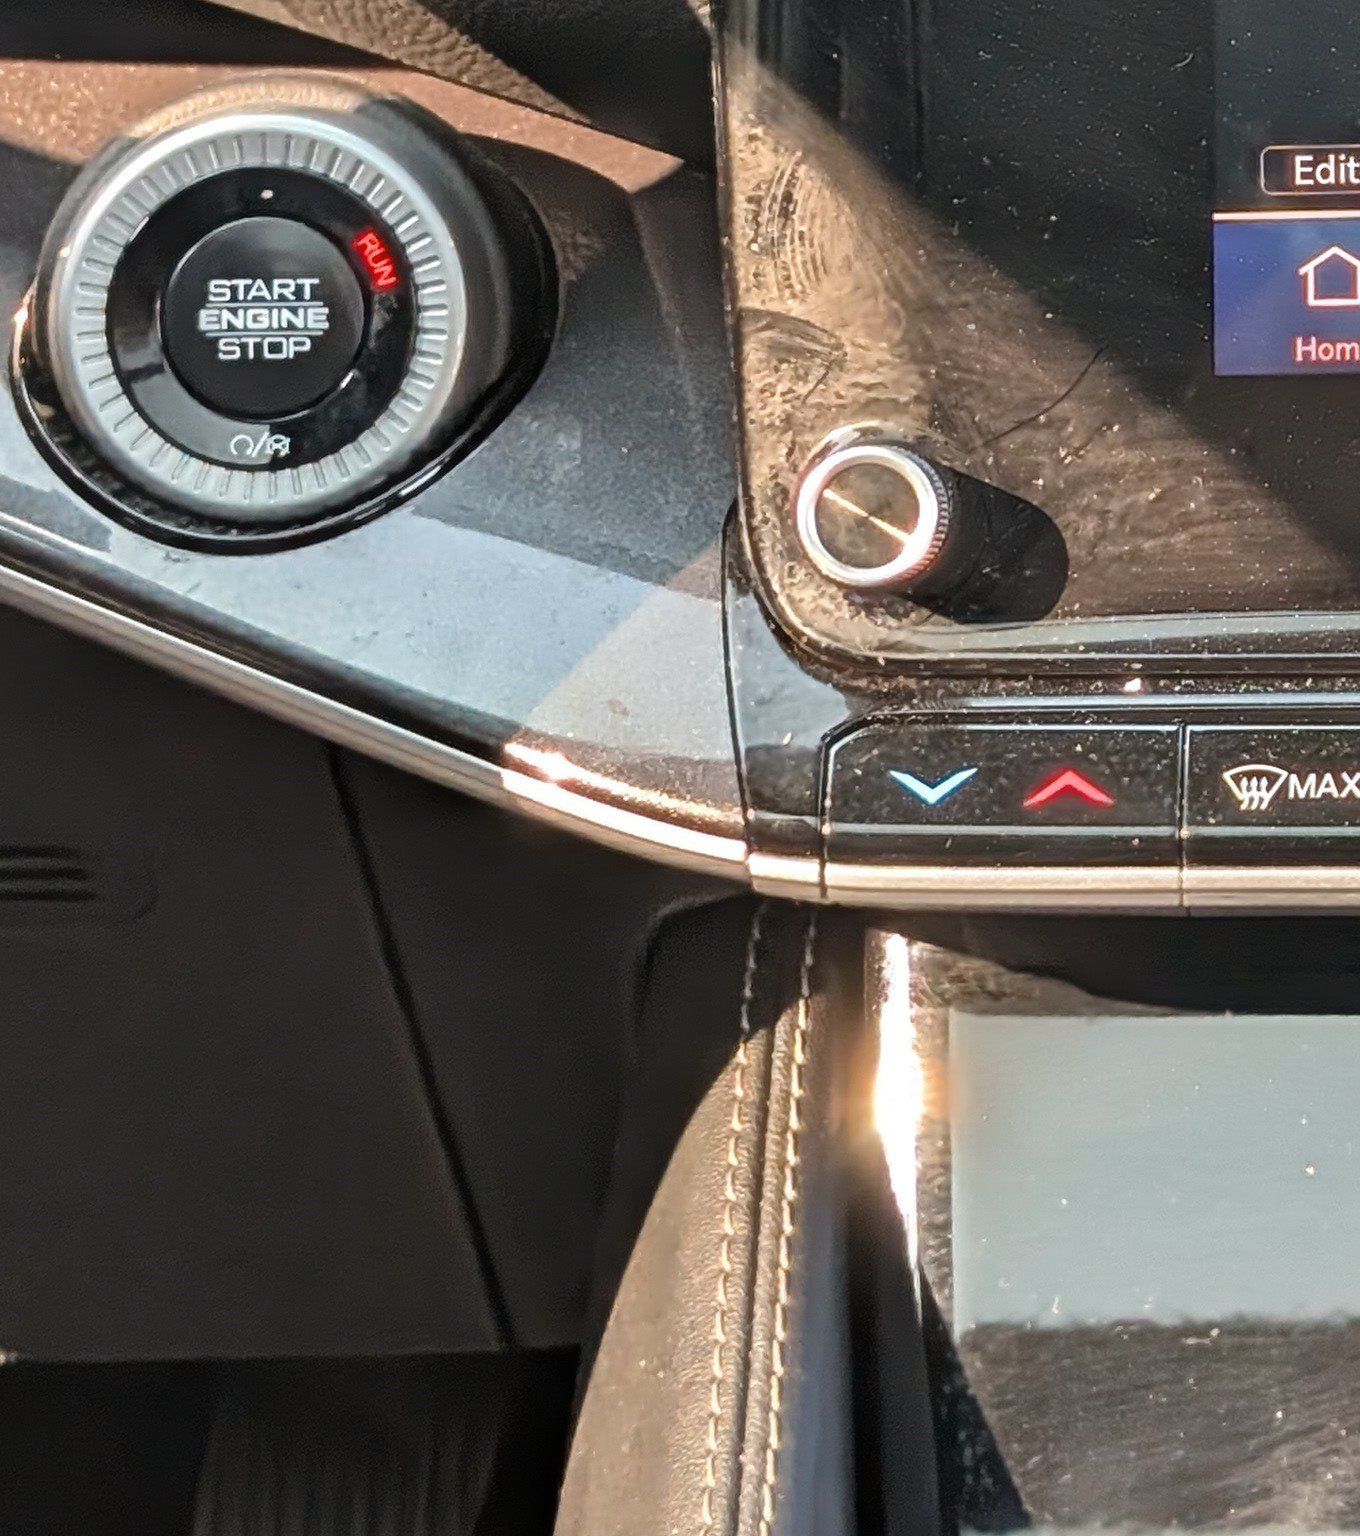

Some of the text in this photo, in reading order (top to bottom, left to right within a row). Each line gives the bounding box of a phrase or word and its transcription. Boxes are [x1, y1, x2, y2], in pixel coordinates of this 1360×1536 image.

[1294, 154, 1360, 187] Edit
[355, 231, 398, 290] RUN
[208, 278, 320, 302] START
[198, 307, 329, 331] ENGINE
[218, 337, 311, 360] STOP
